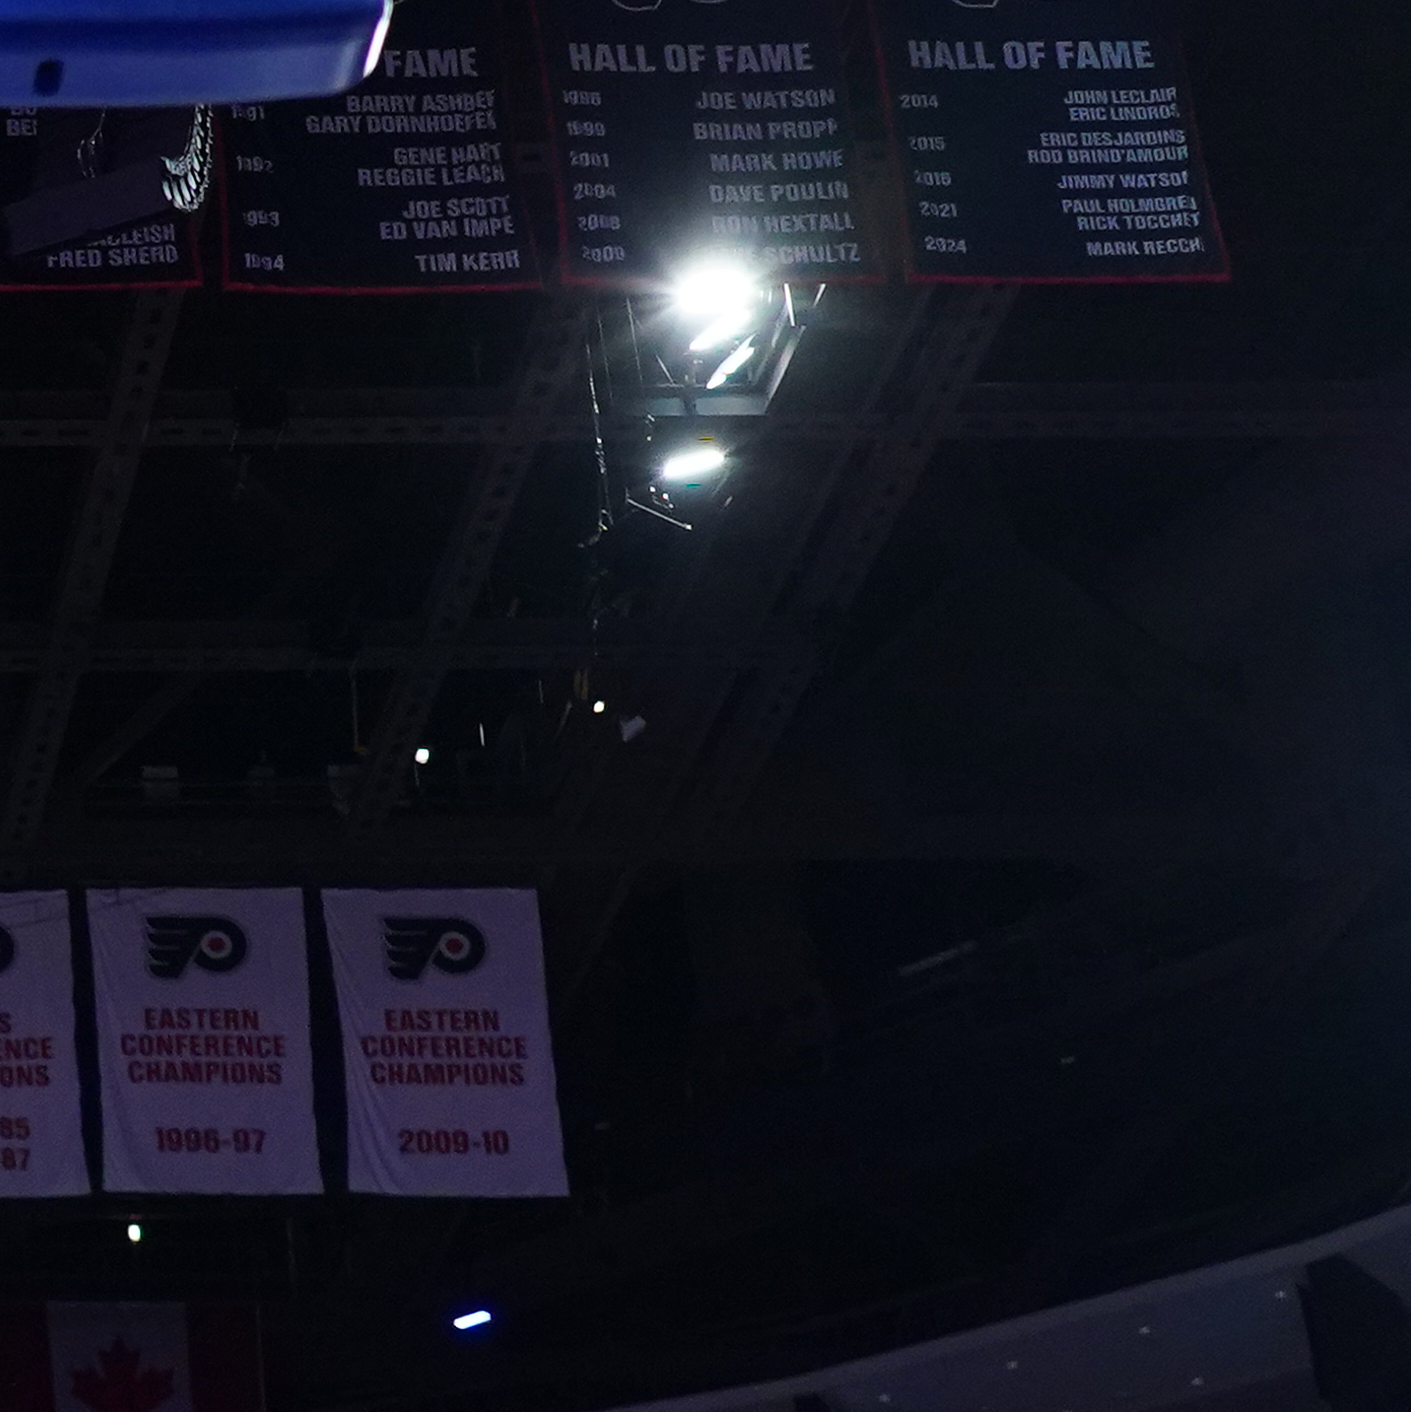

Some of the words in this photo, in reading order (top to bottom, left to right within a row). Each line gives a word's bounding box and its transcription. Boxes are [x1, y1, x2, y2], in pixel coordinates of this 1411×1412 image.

[383, 47, 479, 77] FAME
[568, 42, 656, 73] HALL
[663, 43, 706, 73] OF
[715, 42, 814, 74] FAME
[907, 39, 995, 71] HALL
[1002, 41, 1045, 71] OF
[1055, 40, 1156, 70] FAME
[695, 91, 737, 110] JOE
[741, 88, 836, 110] WATSON
[1063, 88, 1108, 105] JOHN
[1111, 86, 1177, 104] LECLAIR
[1068, 106, 1107, 122] ERIC
[693, 121, 763, 141] BRIAN
[1040, 131, 1078, 147] ERIC
[1081, 128, 1187, 147] DESJARDINS
[393, 147, 447, 166] GENE
[451, 142, 501, 163] HART
[709, 153, 777, 172] MARK
[782, 149, 844, 171] HOWE
[1027, 149, 1063, 164] ROD
[1067, 144, 1189, 164] BRIND'AMOUR
[357, 168, 437, 187] REGGIE
[442, 164, 505, 186] LEACH
[771, 180, 849, 202] POULIN
[402, 199, 443, 220] JOE
[447, 195, 510, 218] SCOTT
[379, 221, 407, 241] ED
[413, 219, 457, 240] VAN
[463, 215, 515, 238] IMPE
[1077, 213, 1120, 231] RICK
[1125, 211, 1201, 231] TOCCHET
[414, 252, 457, 273] TIM
[463, 249, 521, 272] KERR
[1085, 241, 1140, 257] MARK
[143, 1007, 259, 1032] EASTERN
[384, 1008, 499, 1033] EASTERN
[120, 1033, 285, 1059] CONFERENCE
[360, 1035, 526, 1060] CONFERENCE
[127, 1060, 282, 1085] CHAMPIONS
[368, 1061, 524, 1087] CHAMPIONS
[397, 1128, 510, 1154] 2009-10
